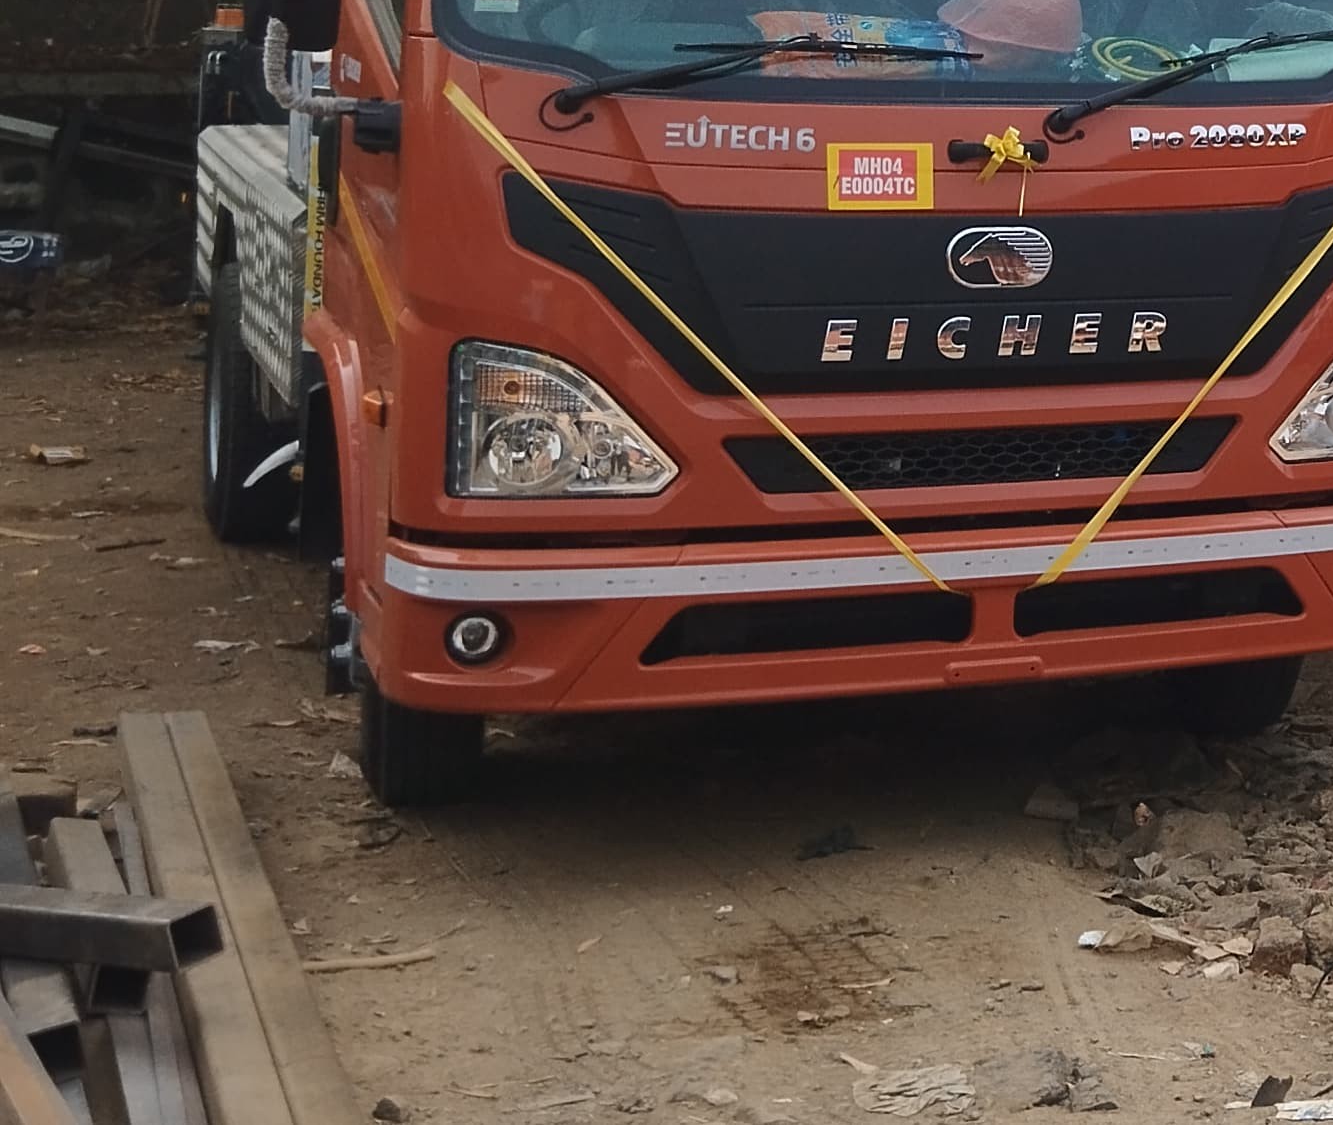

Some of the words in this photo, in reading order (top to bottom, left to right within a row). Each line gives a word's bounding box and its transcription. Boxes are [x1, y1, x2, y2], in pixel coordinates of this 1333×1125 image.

[796, 127, 817, 152] 6
[1130, 127, 1185, 150] Pro
[1190, 123, 1307, 148] 2080XP
[854, 156, 904, 176] MH04
[841, 176, 916, 195] E0004TC
[311, 230, 325, 311] FOUNDAT
[820, 311, 1167, 362] EICHER
